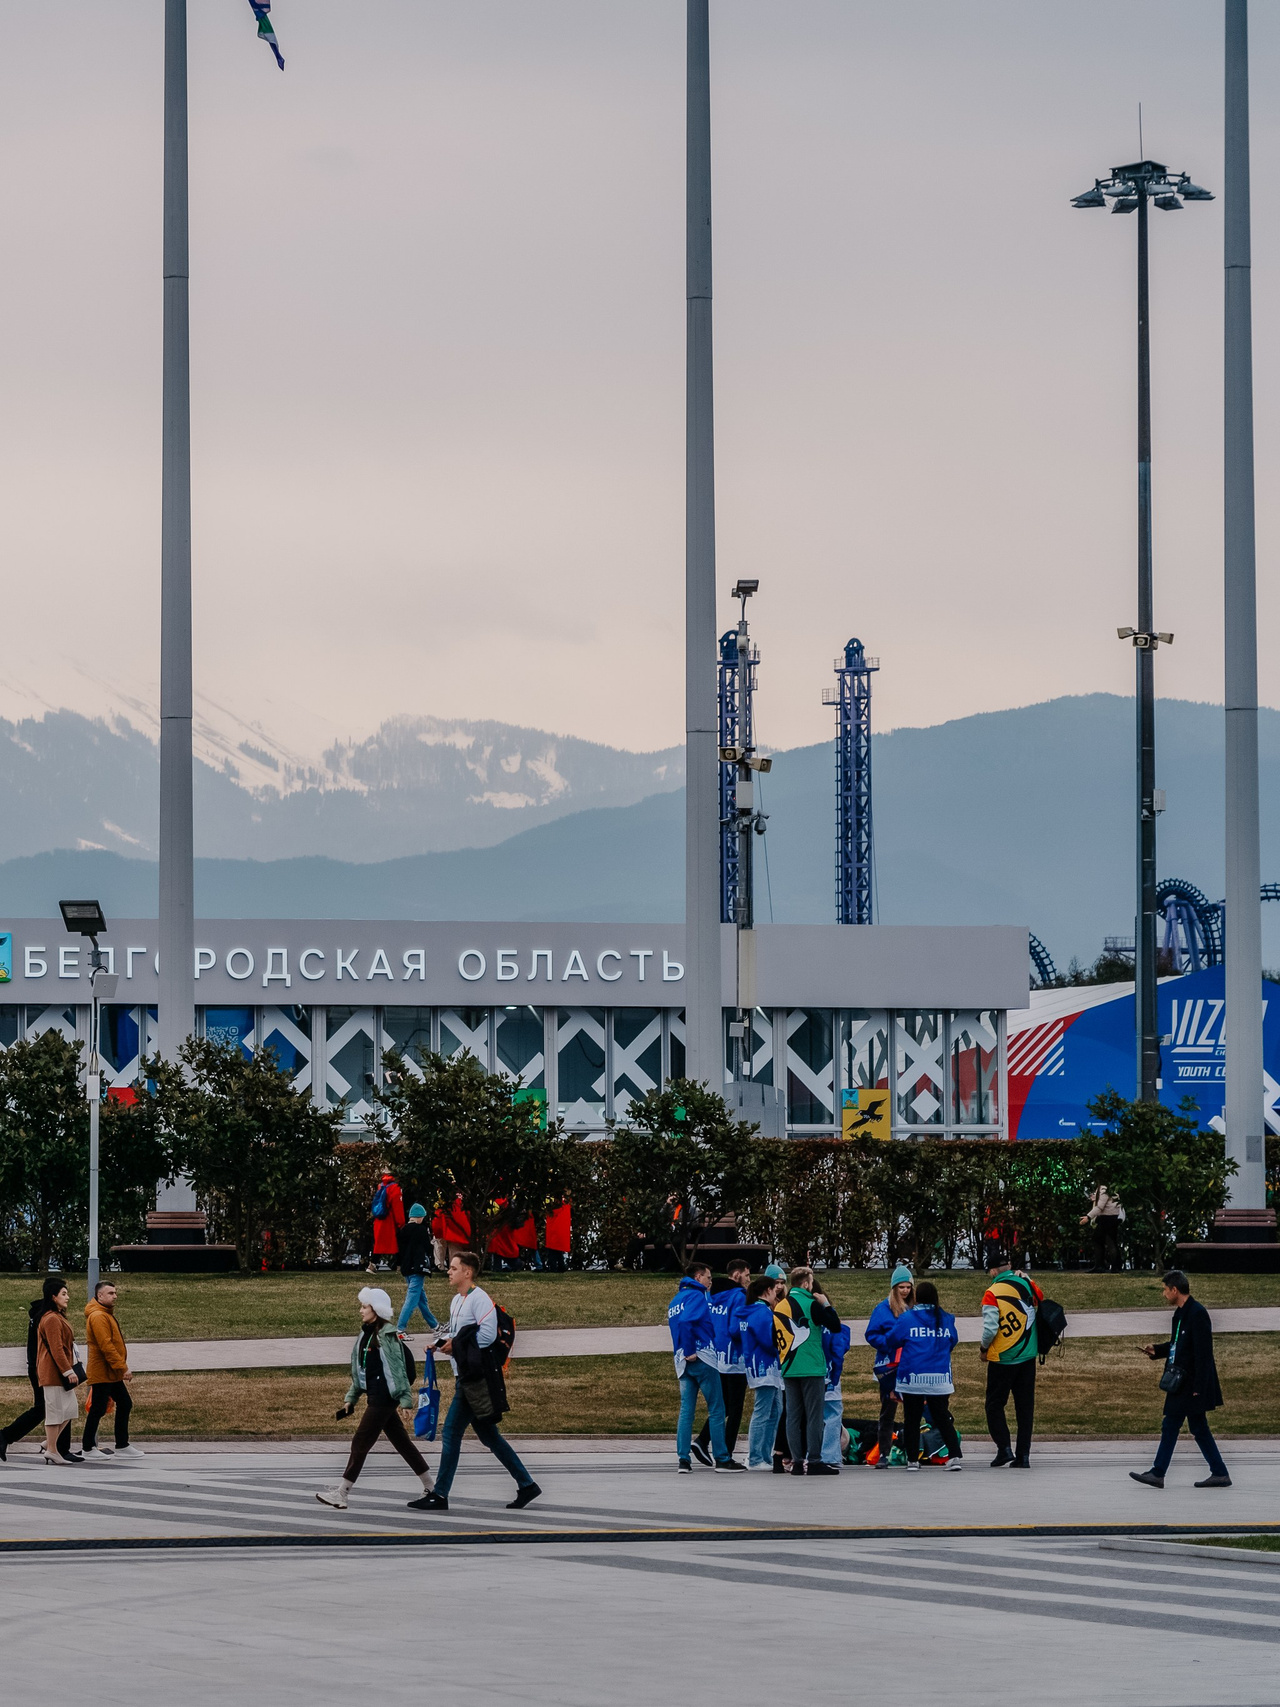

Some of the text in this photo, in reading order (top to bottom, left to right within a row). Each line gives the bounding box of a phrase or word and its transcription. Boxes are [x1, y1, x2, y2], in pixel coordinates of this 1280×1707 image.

[23, 946, 686, 987] БЕЛГРОДСКАЯ ОБЛАСТЬ
[1178, 1066, 1211, 1077] YOUTH
[668, 1302, 685, 1318] ЕНЗА
[910, 1327, 951, 1338] ПЕНЗА
[1000, 1311, 1022, 1338] 58
